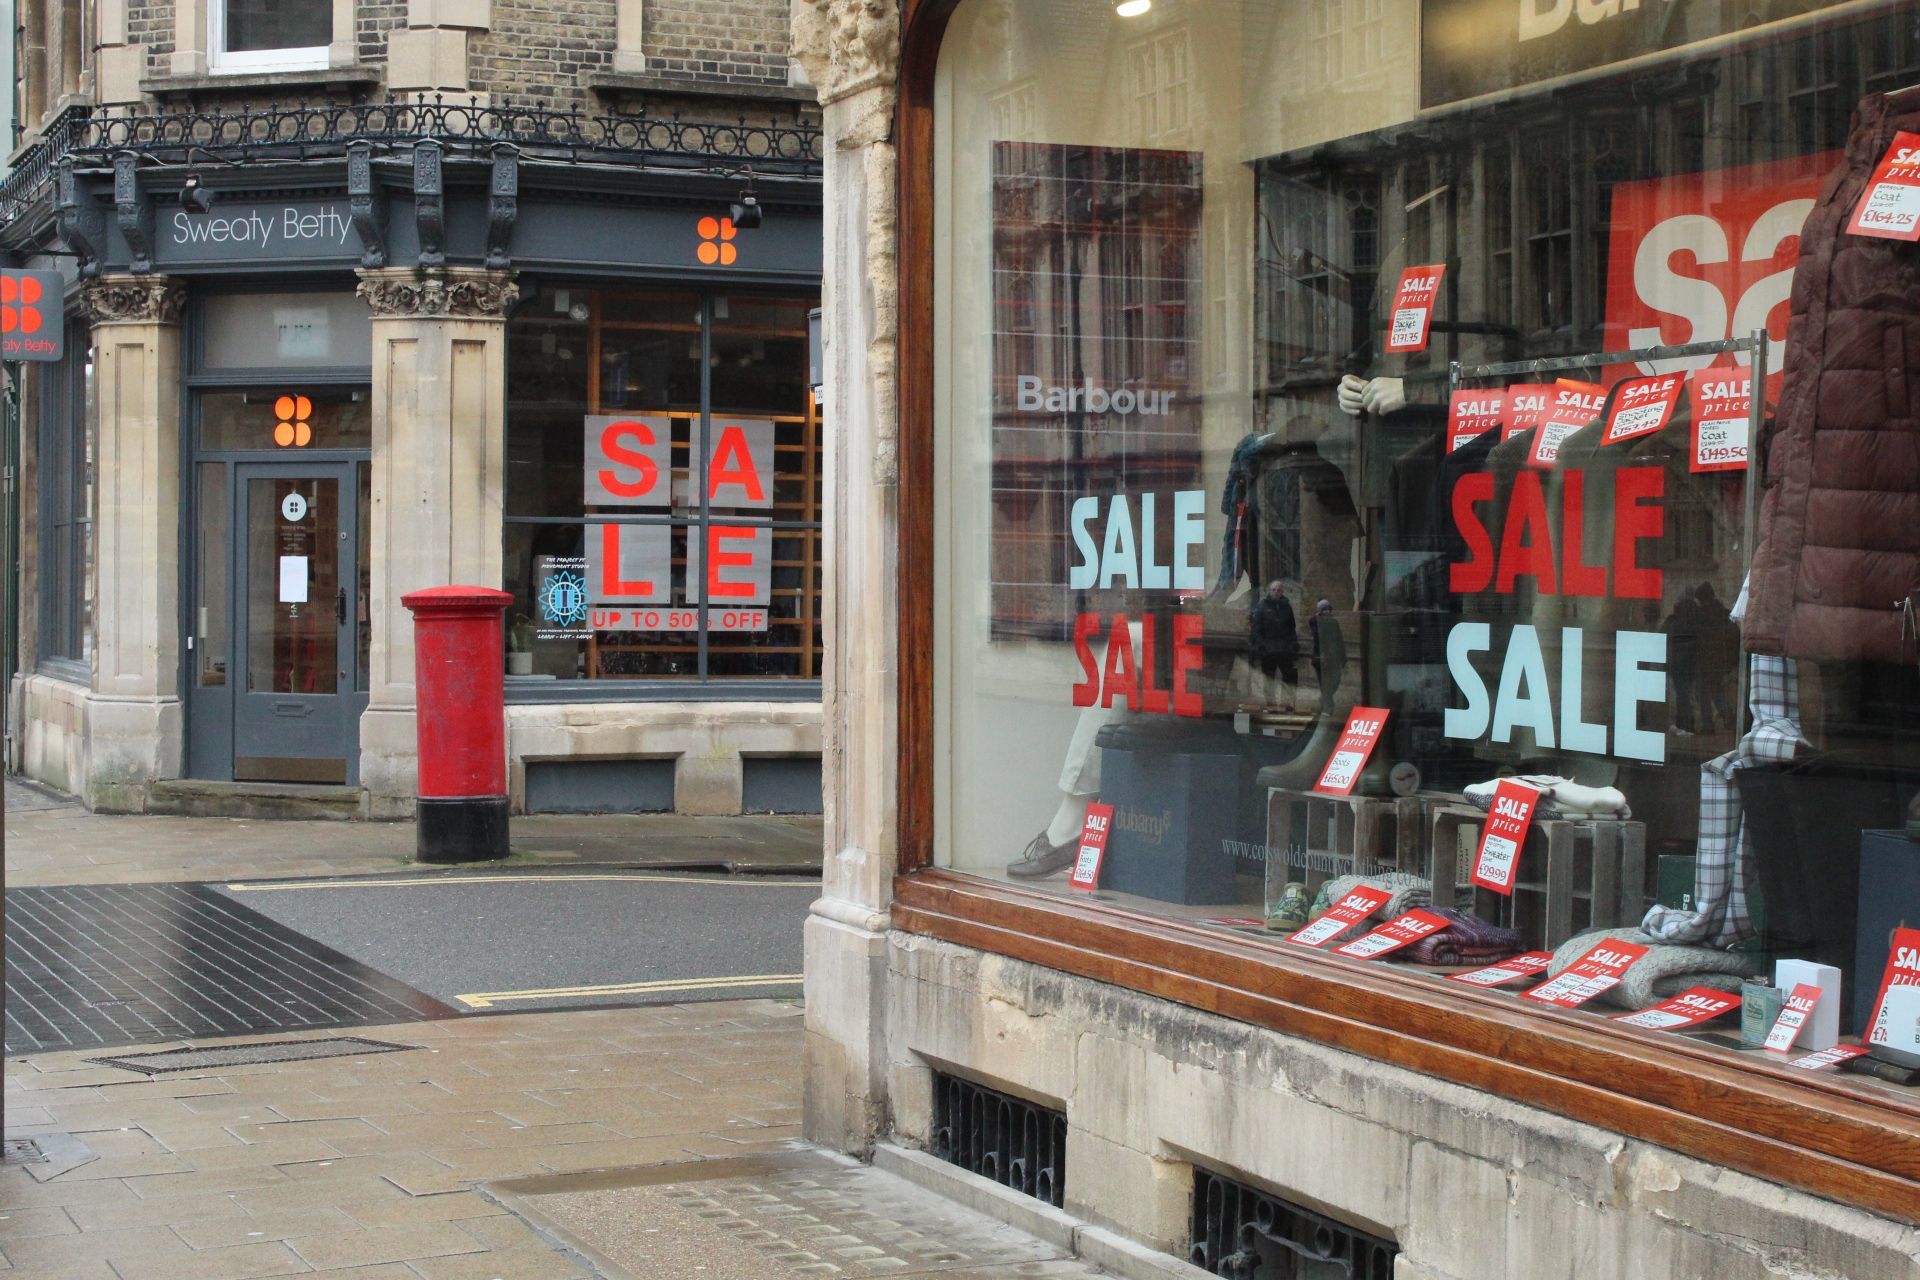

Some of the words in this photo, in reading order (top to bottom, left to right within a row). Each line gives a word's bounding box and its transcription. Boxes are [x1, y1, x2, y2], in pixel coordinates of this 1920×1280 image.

[1873, 190, 1902, 202] Coat
[1864, 209, 1915, 225] £164.25
[173, 210, 274, 249] Sweaty
[283, 205, 352, 245] Betty
[1401, 276, 1437, 293] SALE
[1399, 292, 1430, 306] price
[25, 337, 58, 355] Betty
[1392, 332, 1419, 344] £171.75
[1017, 374, 1176, 416] Barbour
[1622, 379, 1676, 400] SALE
[1700, 379, 1751, 401] SALE
[1456, 399, 1501, 417] SALE
[1555, 390, 1606, 411] SALE
[1622, 391, 1670, 409] price
[1703, 399, 1750, 417] price
[1553, 407, 1600, 422] price
[1457, 418, 1496, 431] price
[1701, 430, 1728, 441] Coat
[1699, 446, 1748, 461] £149.50
[1070, 490, 1205, 590] SALE
[1449, 466, 1665, 600] SALE
[592, 611, 621, 628] UP
[631, 612, 660, 628] TO
[722, 612, 763, 629] OFF
[1073, 612, 1204, 718] SALE
[1444, 622, 1668, 763] SALE
[1346, 719, 1380, 737] SALE
[1342, 735, 1371, 748] price
[1494, 796, 1529, 821] SALE
[1085, 814, 1107, 832] SALE
[1116, 804, 1164, 846] dubarry
[1491, 818, 1521, 834] price
[1083, 830, 1103, 843] price
[1478, 862, 1507, 881] £29.99
[1339, 894, 1378, 913] SALE
[1329, 908, 1361, 920] price
[1381, 926, 1414, 939] price
[1393, 916, 1435, 934] SALE
[1498, 963, 1538, 971] price
[1588, 948, 1633, 969] SALE
[1574, 963, 1612, 976] price
[1661, 1004, 1707, 1016] price
[1675, 994, 1730, 1012] SALE
[1785, 995, 1814, 1012] SALE
